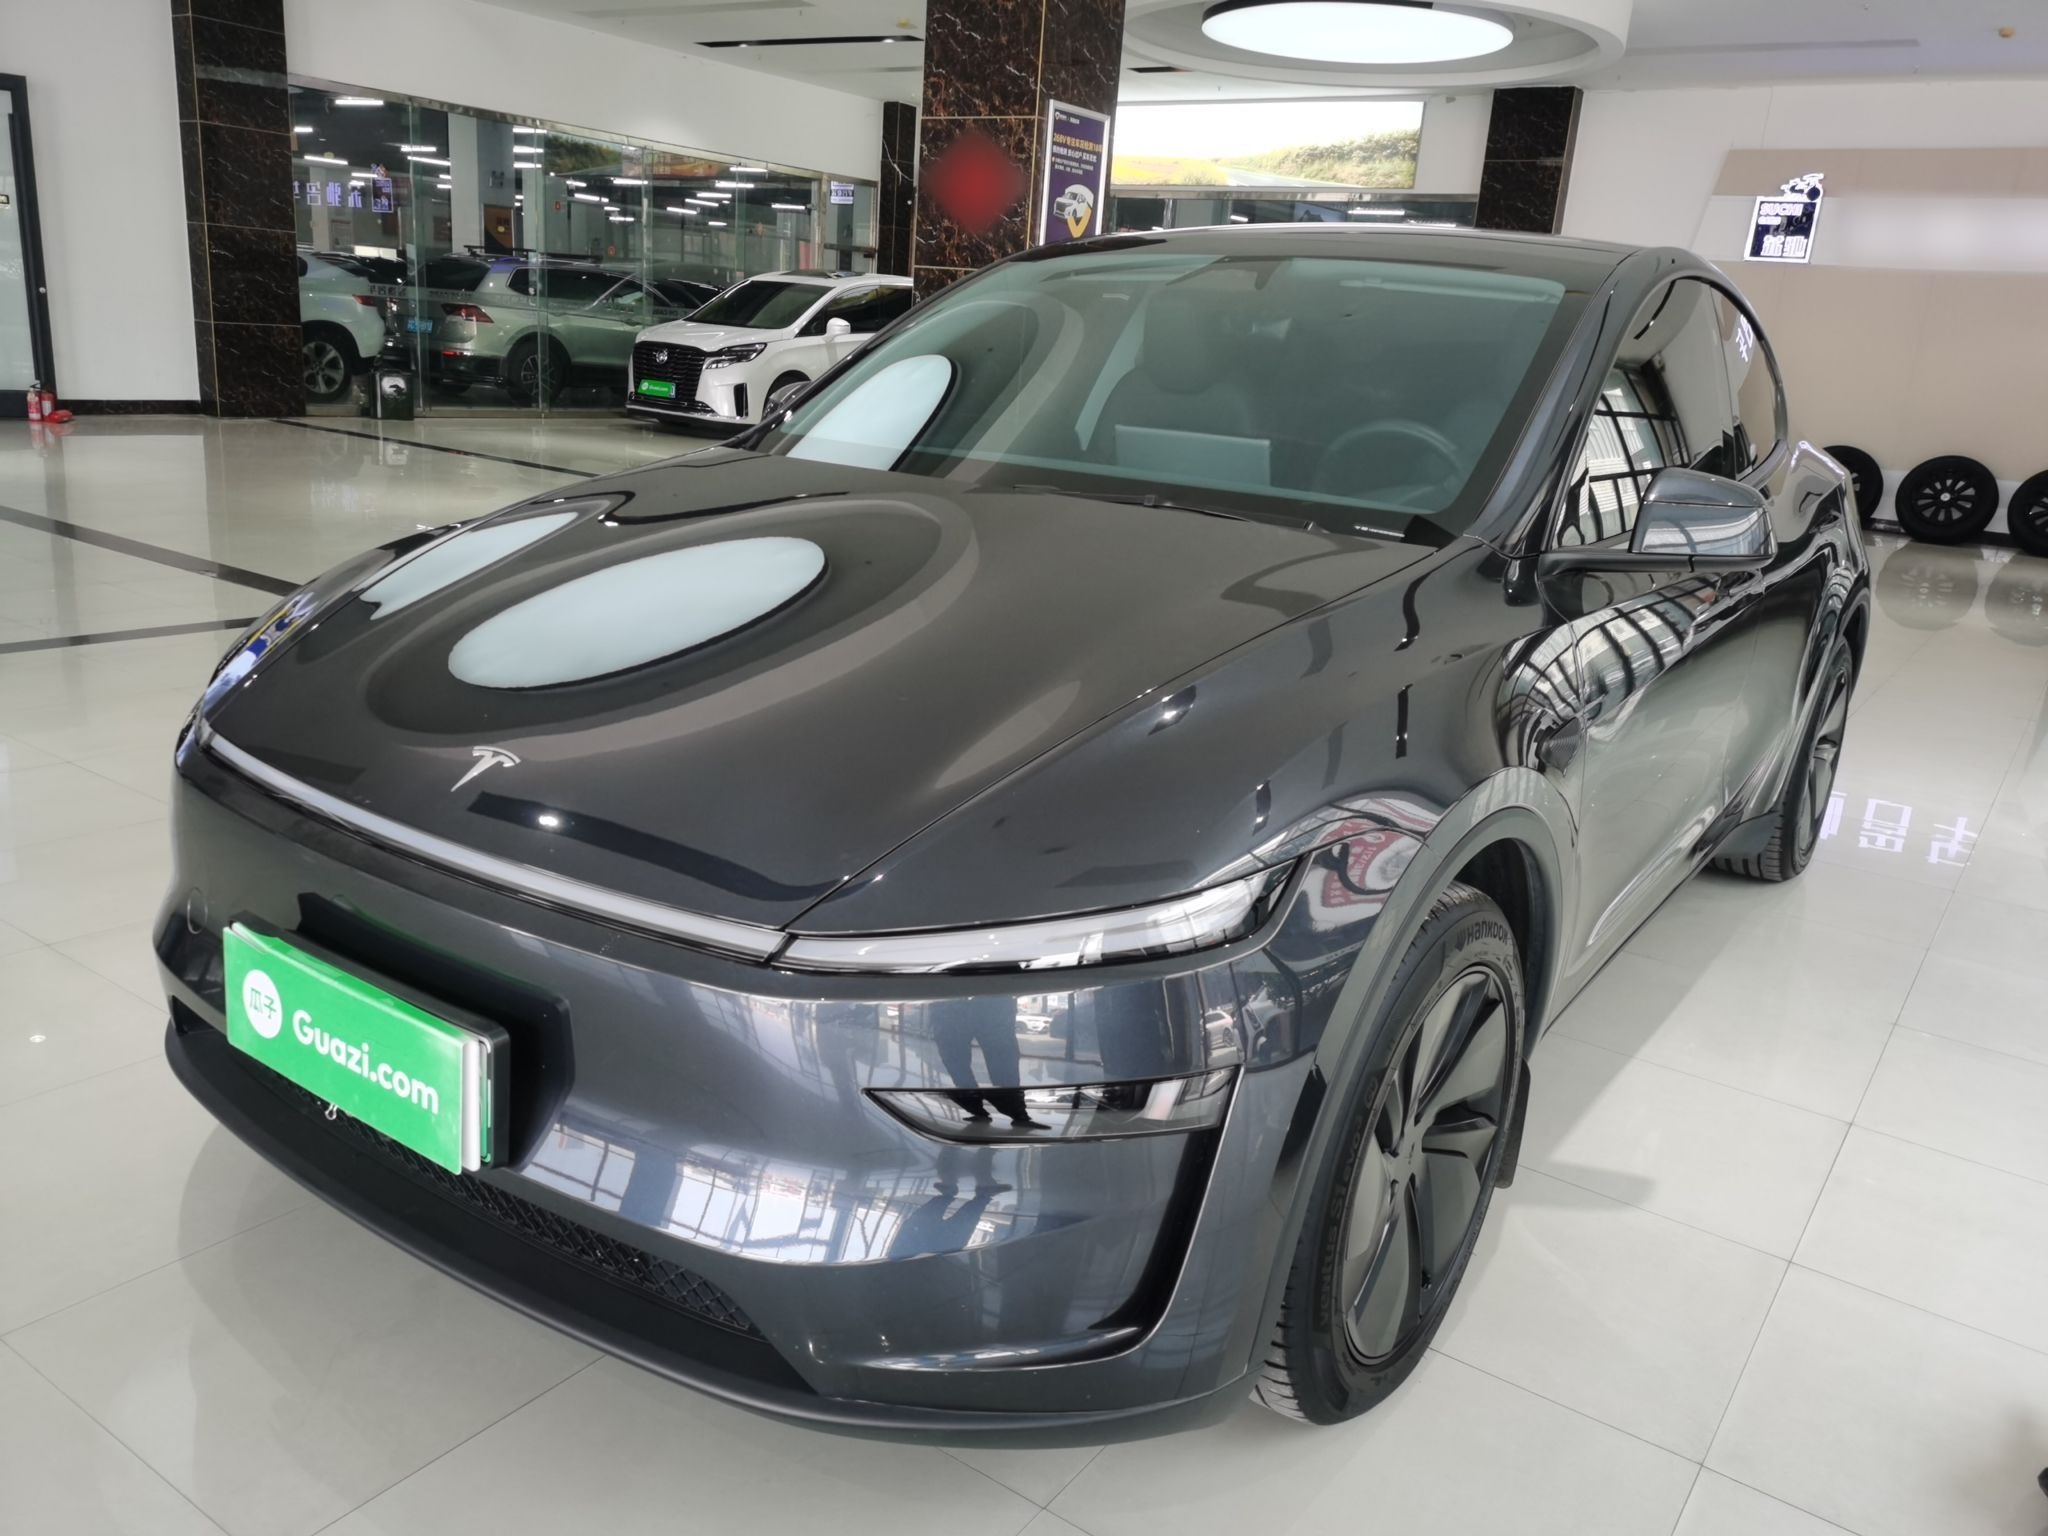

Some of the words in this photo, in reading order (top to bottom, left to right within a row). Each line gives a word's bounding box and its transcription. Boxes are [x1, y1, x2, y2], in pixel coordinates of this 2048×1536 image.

[1759, 203, 1803, 216] SUCHI
[249, 987, 278, 1021] 瓜子
[292, 1009, 440, 1115] Guazi.com
